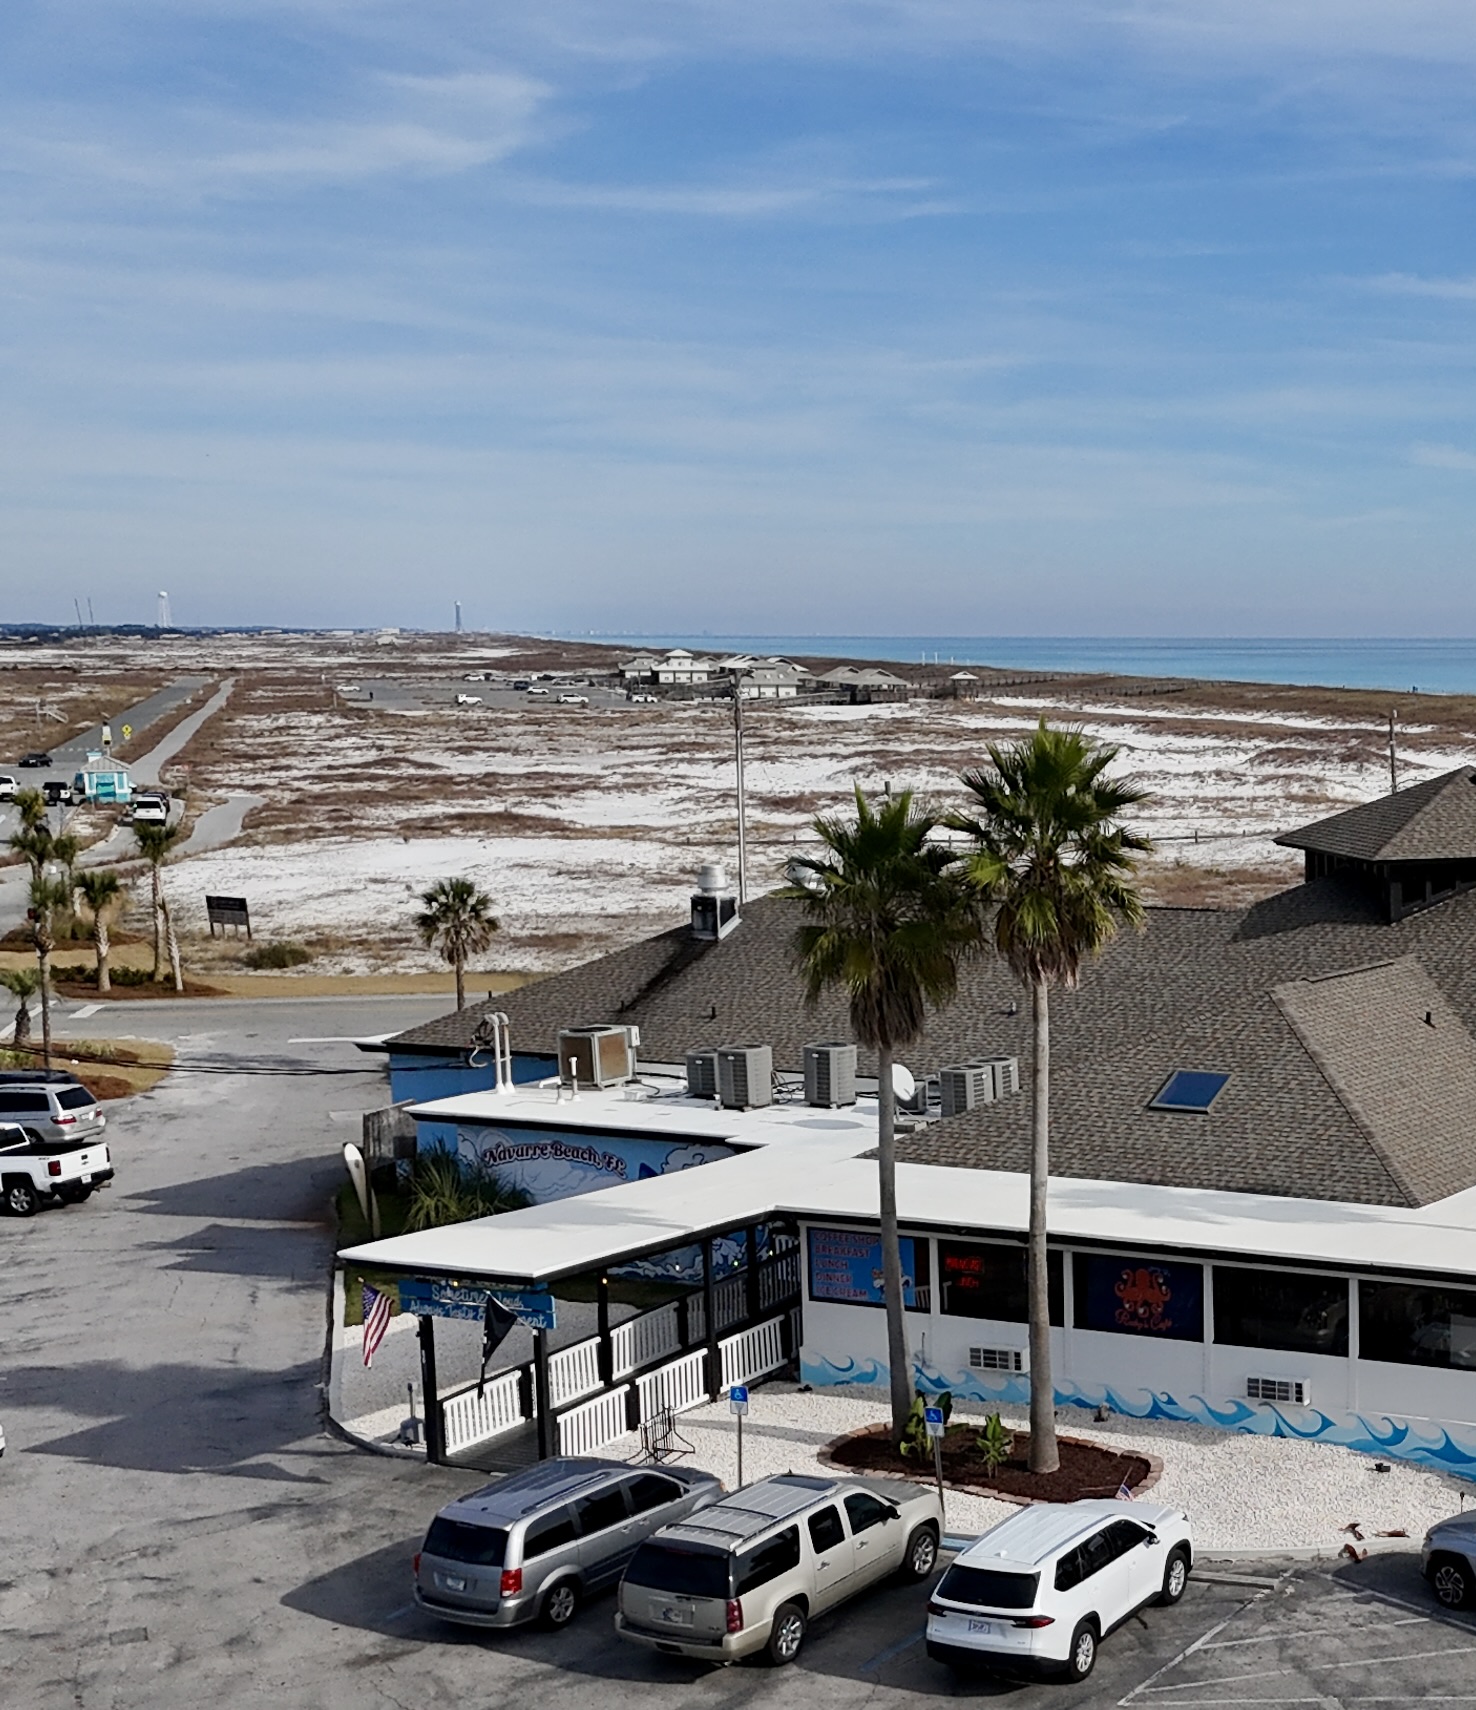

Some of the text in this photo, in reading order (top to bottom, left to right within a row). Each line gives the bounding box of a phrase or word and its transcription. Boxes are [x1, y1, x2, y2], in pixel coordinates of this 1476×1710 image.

[484, 1140, 628, 1179] Navarre Beach, FL
[815, 1244, 870, 1258] BREAKFAST
[815, 1259, 848, 1270] LUNCH
